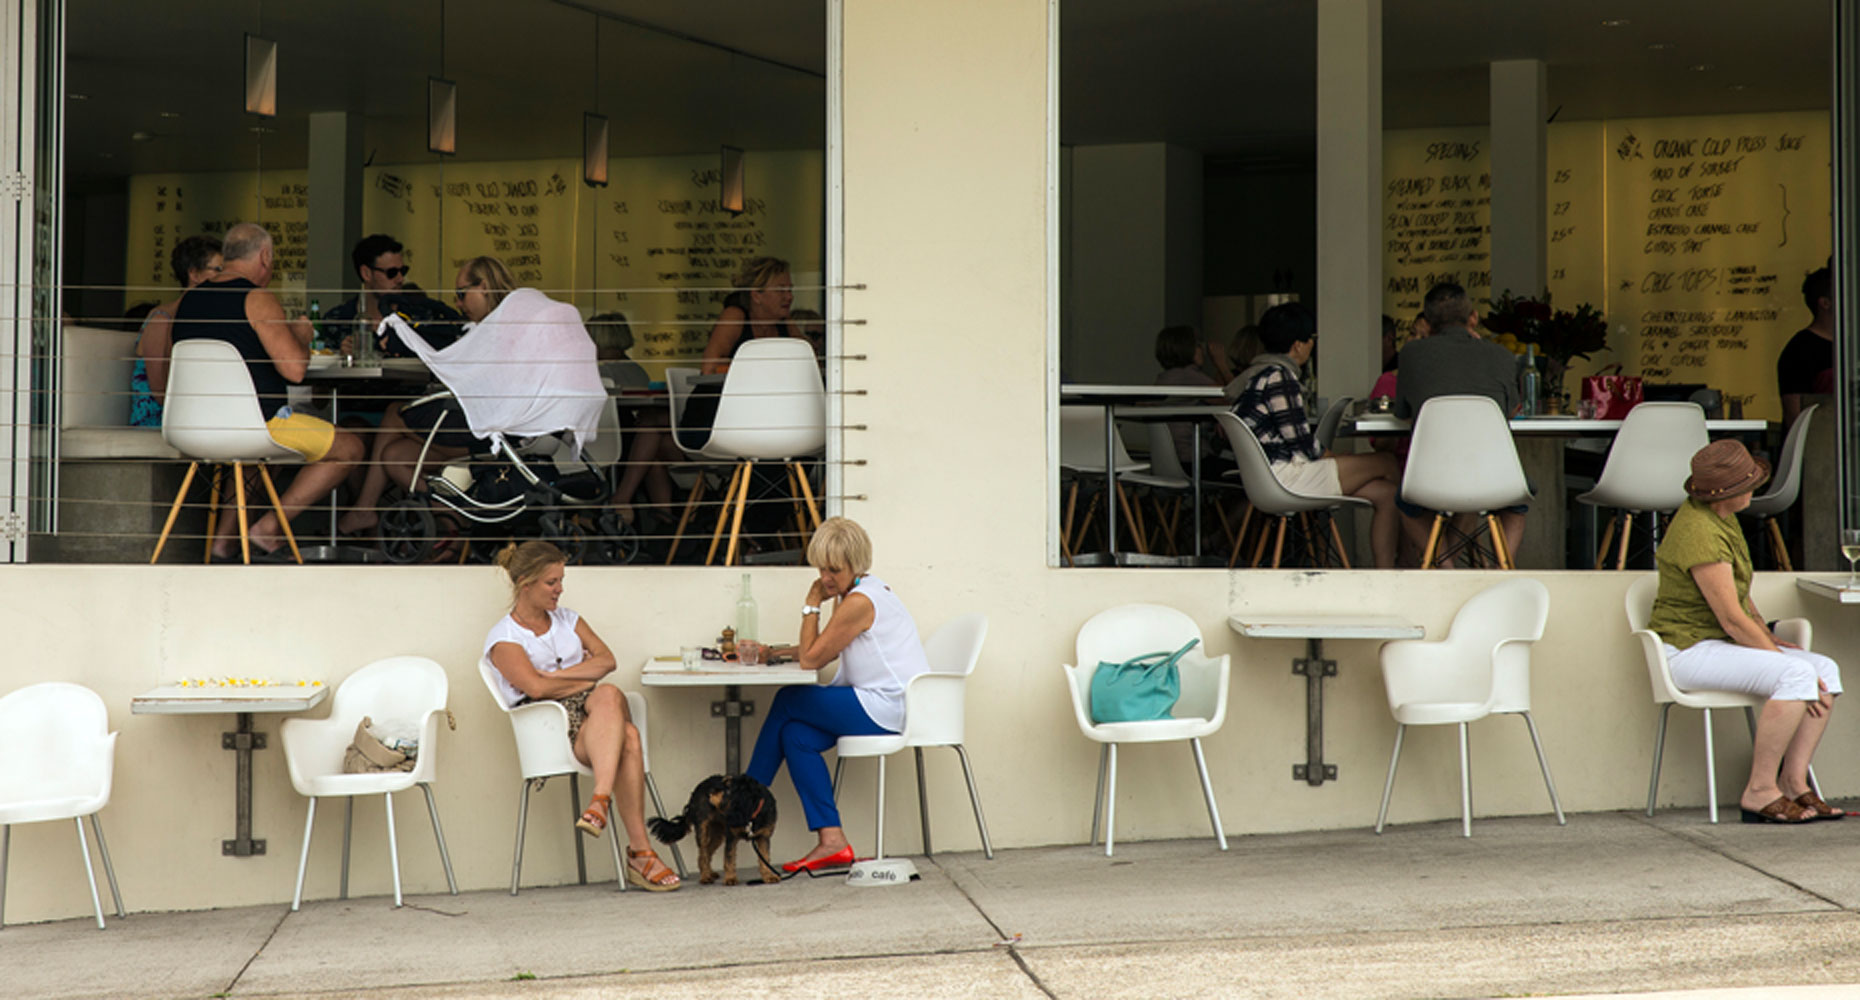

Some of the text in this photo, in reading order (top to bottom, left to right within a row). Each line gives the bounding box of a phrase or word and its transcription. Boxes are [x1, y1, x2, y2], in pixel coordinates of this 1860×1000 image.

[1425, 140, 1480, 163] SPECIALS
[1702, 137, 1731, 156] COLD
[1736, 135, 1767, 152] PRESS
